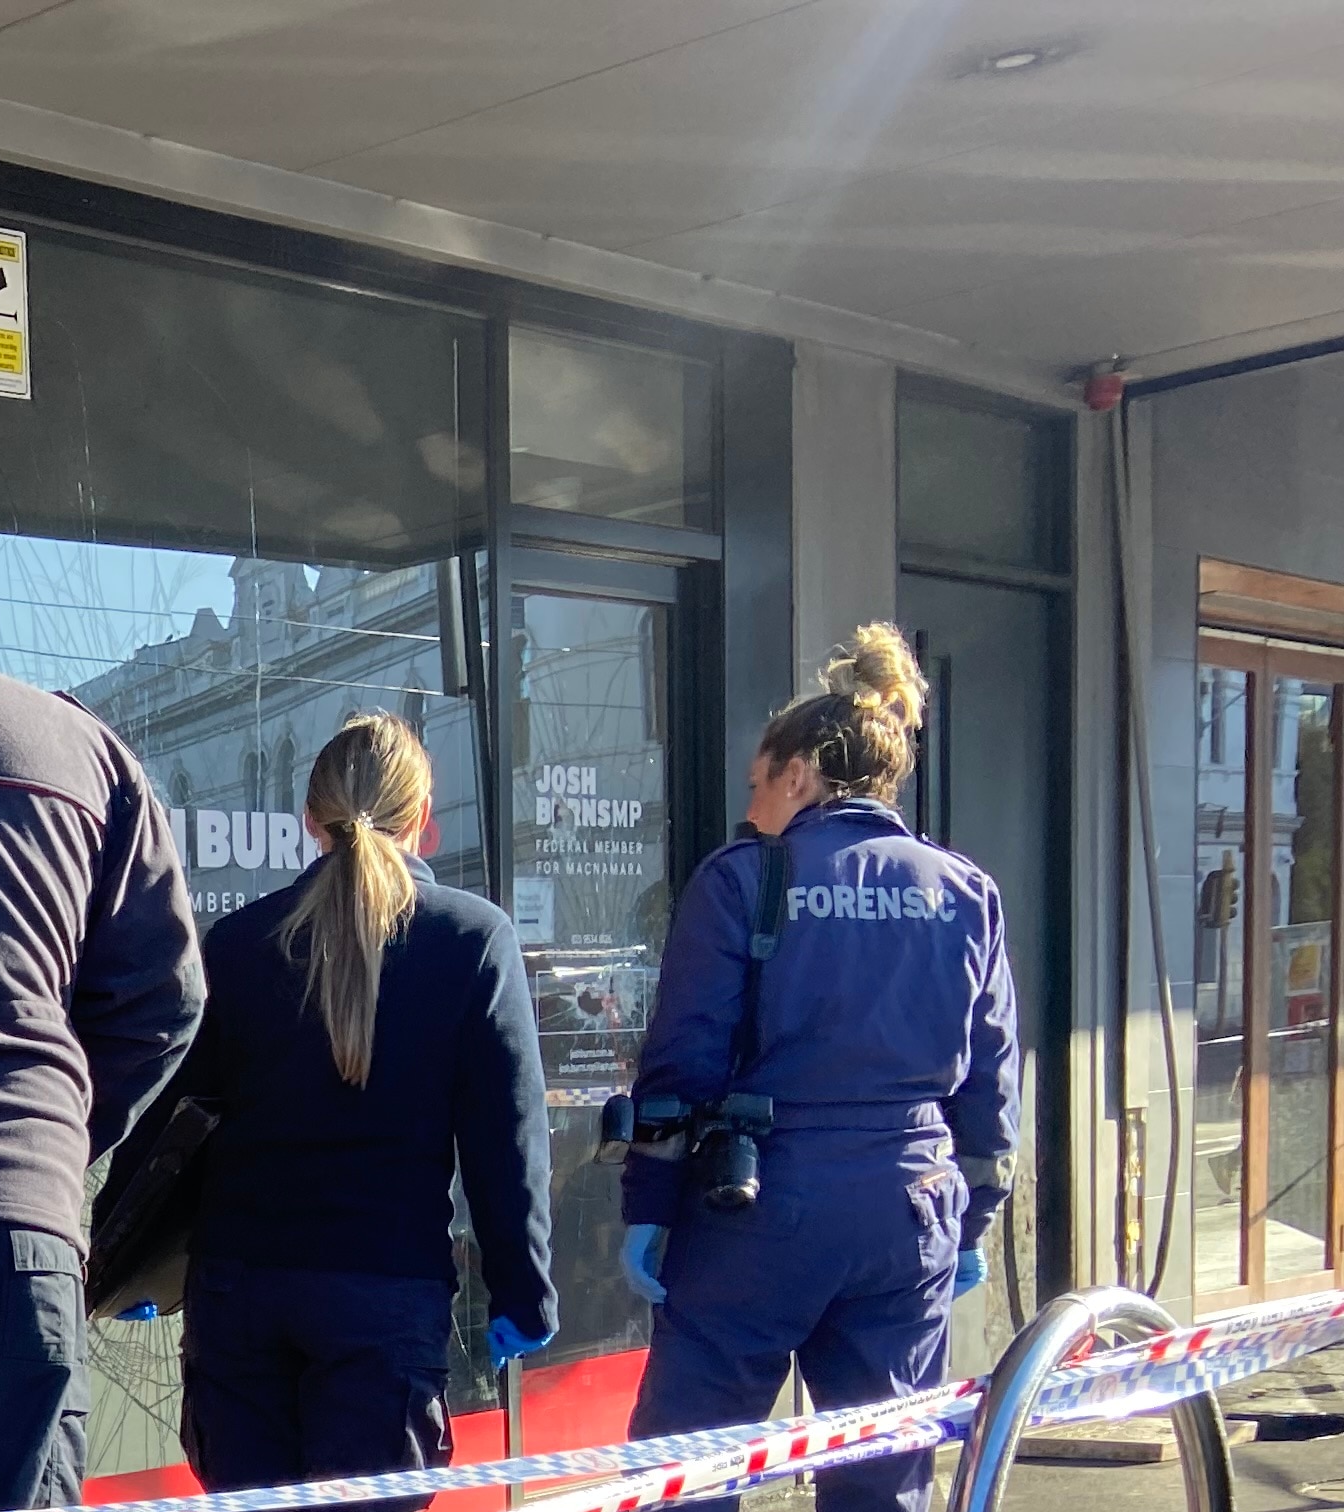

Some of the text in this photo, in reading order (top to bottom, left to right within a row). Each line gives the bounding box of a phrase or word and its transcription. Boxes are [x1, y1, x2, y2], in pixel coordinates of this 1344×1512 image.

[535, 764, 597, 795] JOSH
[535, 838, 644, 855] FEDERAL MEMBER
[535, 860, 644, 876] FOR MACNAMARA
[786, 884, 957, 922] FORENSIC
